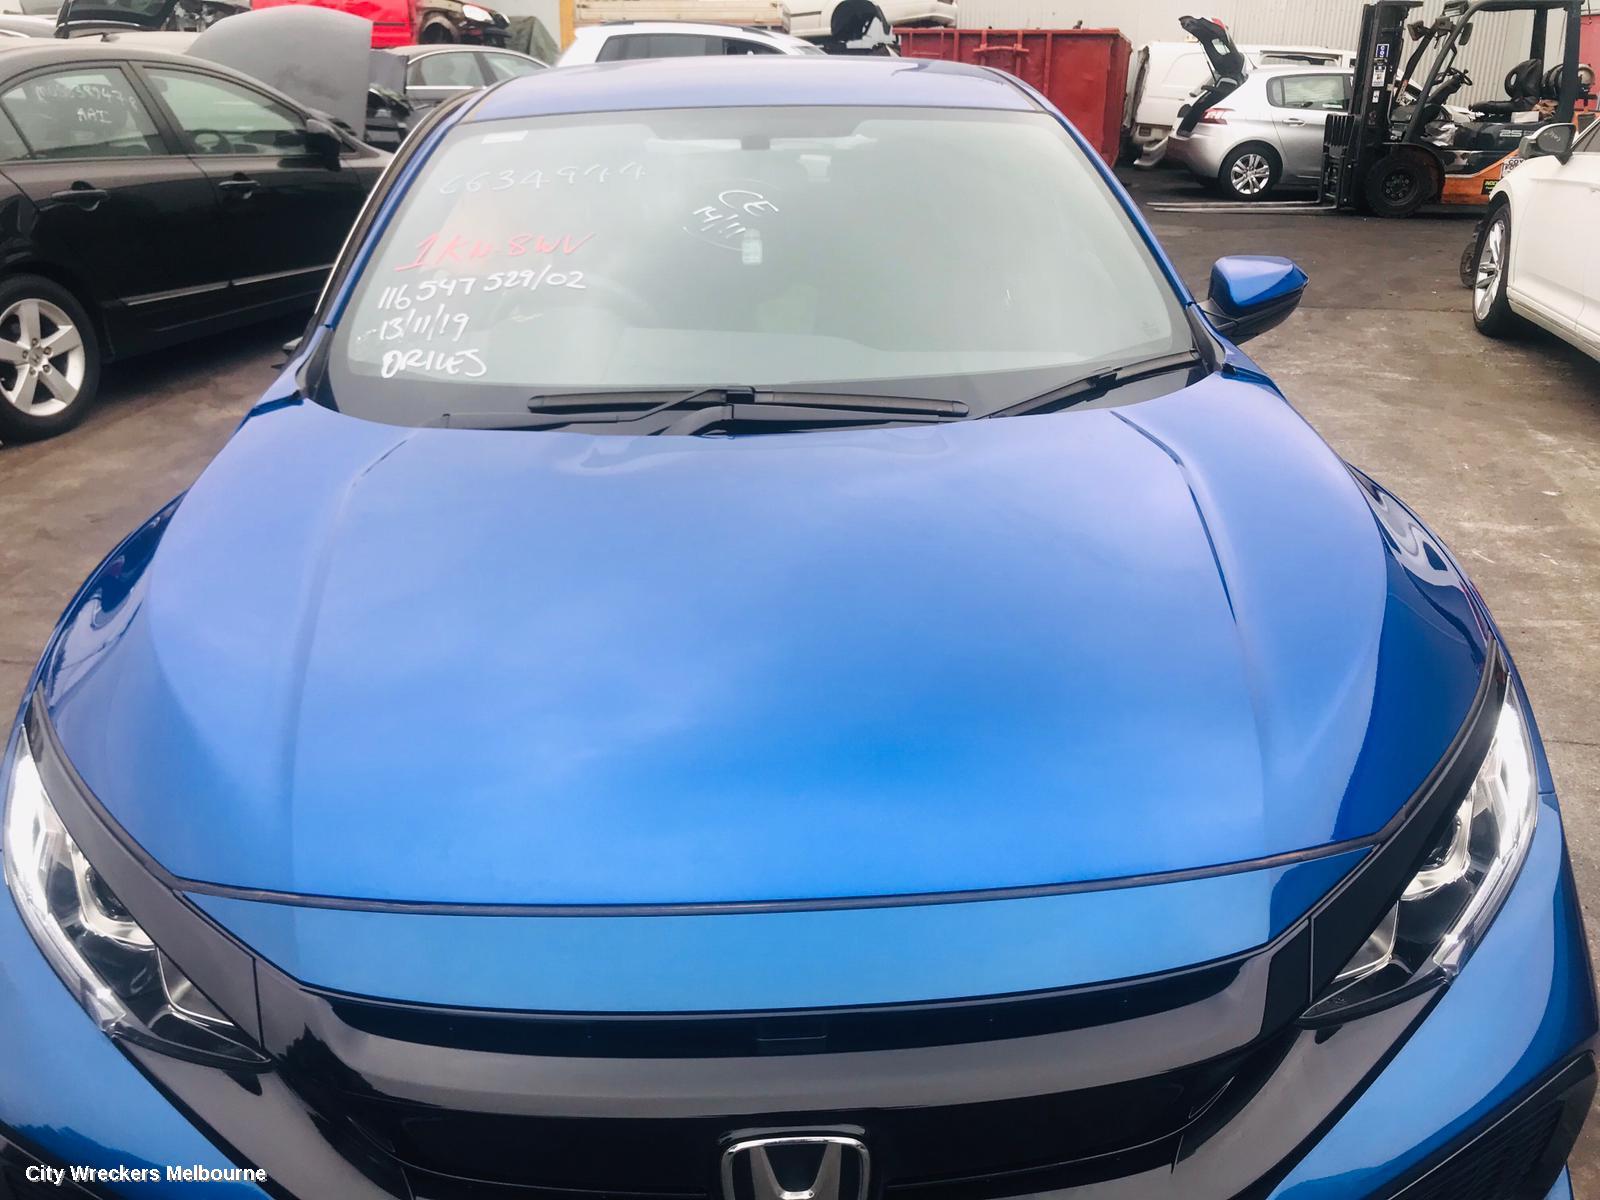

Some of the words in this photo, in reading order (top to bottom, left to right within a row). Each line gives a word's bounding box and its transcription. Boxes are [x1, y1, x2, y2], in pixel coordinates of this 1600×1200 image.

[378, 284, 411, 310] 116
[416, 277, 476, 301] 547
[483, 264, 587, 292] 529/02
[379, 304, 470, 342] 13/11/19
